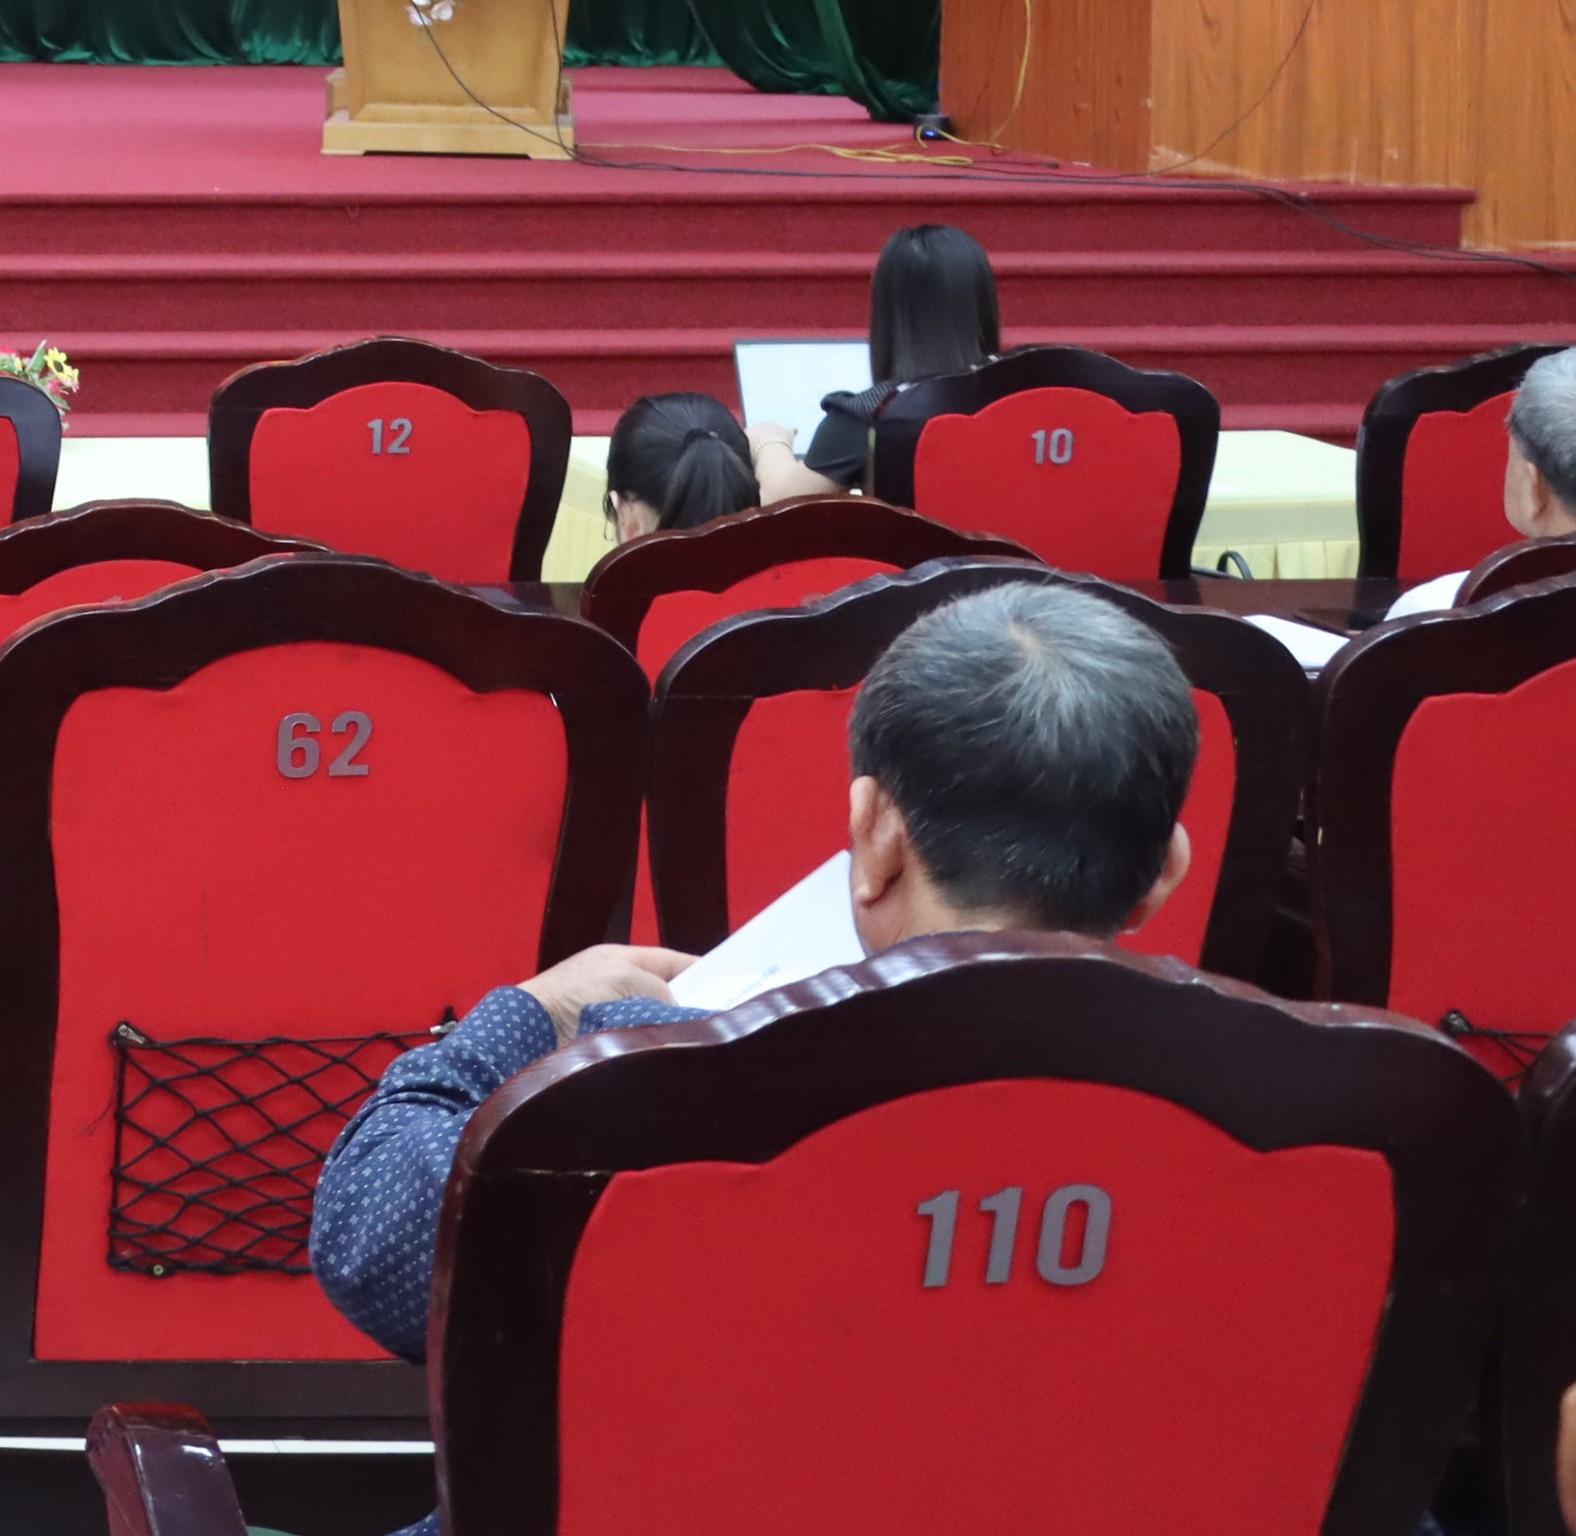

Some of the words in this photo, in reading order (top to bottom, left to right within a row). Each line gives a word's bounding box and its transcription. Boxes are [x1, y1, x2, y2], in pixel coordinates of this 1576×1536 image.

[368, 418, 413, 454] 12
[1032, 428, 1075, 465] 10
[278, 711, 373, 779] 62
[916, 1184, 1113, 1289] 110
